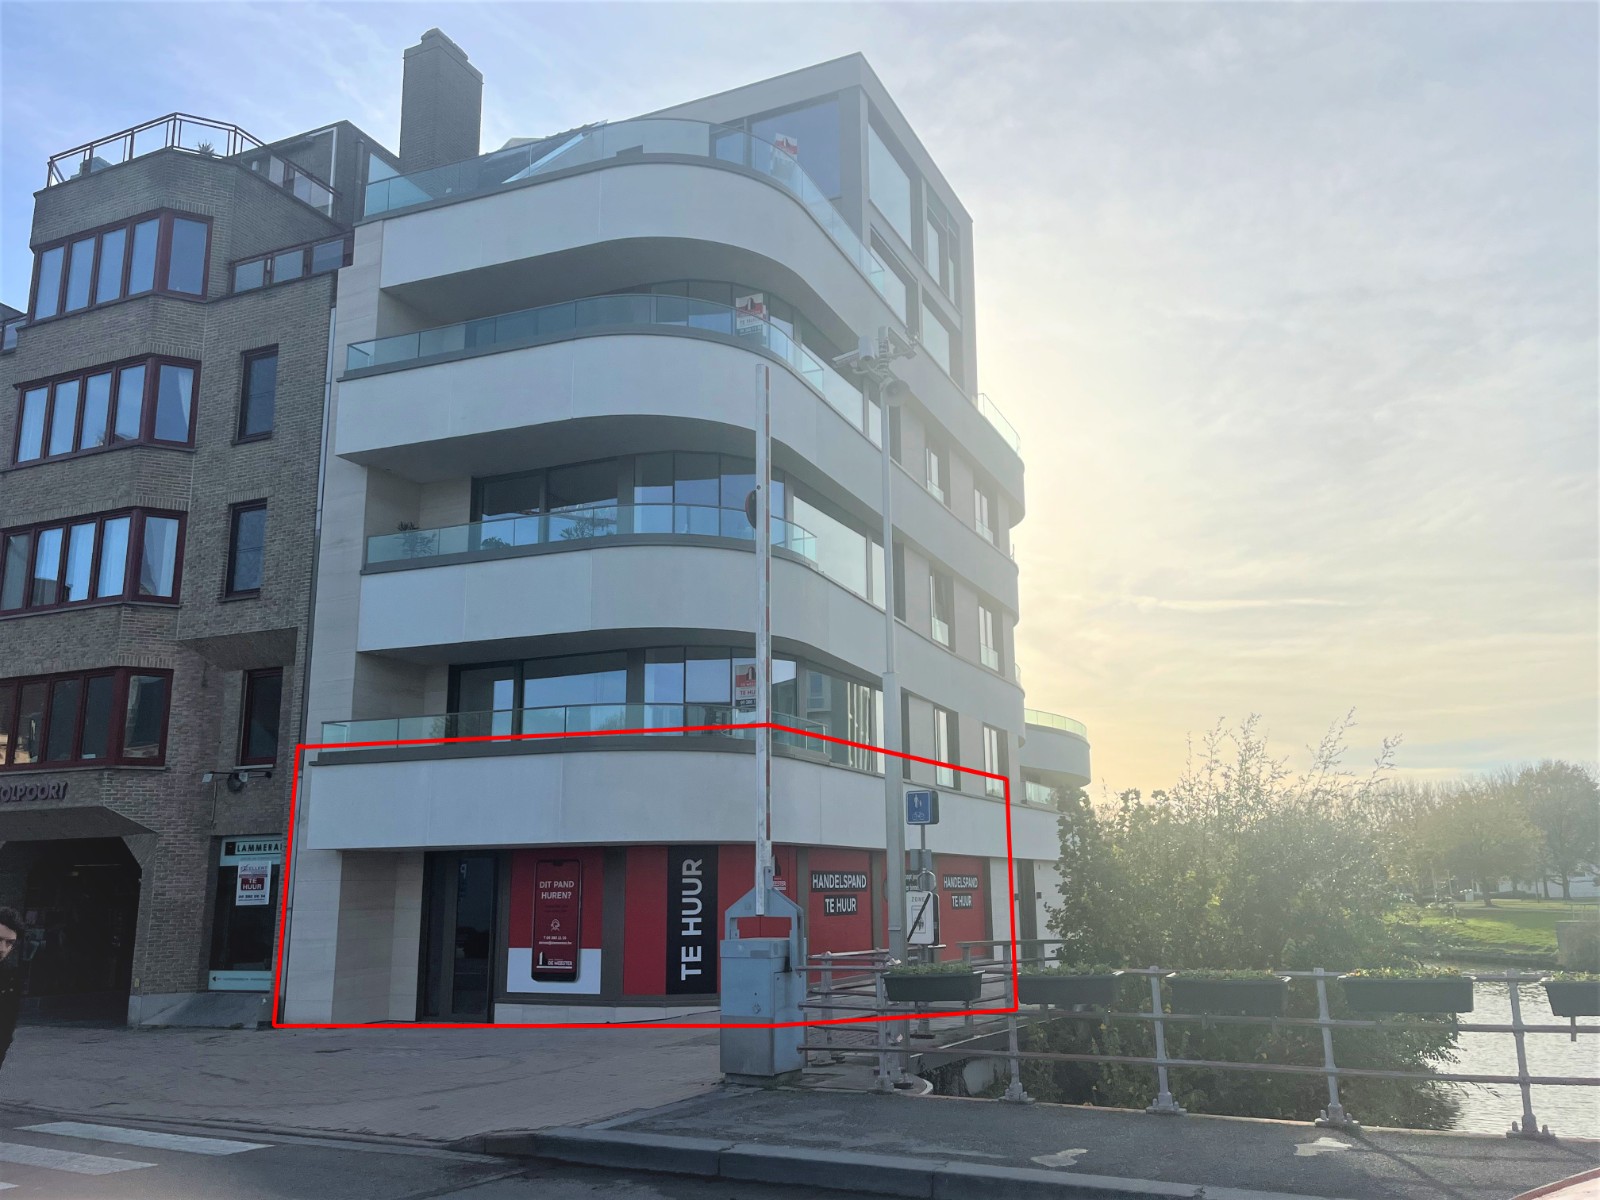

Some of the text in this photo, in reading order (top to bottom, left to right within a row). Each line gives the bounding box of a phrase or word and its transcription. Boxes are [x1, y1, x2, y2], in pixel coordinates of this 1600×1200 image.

[0, 782, 68, 802] OLPOORT
[539, 881, 552, 889] DIT
[812, 874, 867, 889] HANDELSPAND
[943, 876, 978, 888] HANDELSPAND
[541, 891, 572, 900] HUREN?
[951, 895, 972, 908] TE HUUR
[824, 898, 857, 913] TE HUUR
[681, 858, 703, 981] TE HUUR
